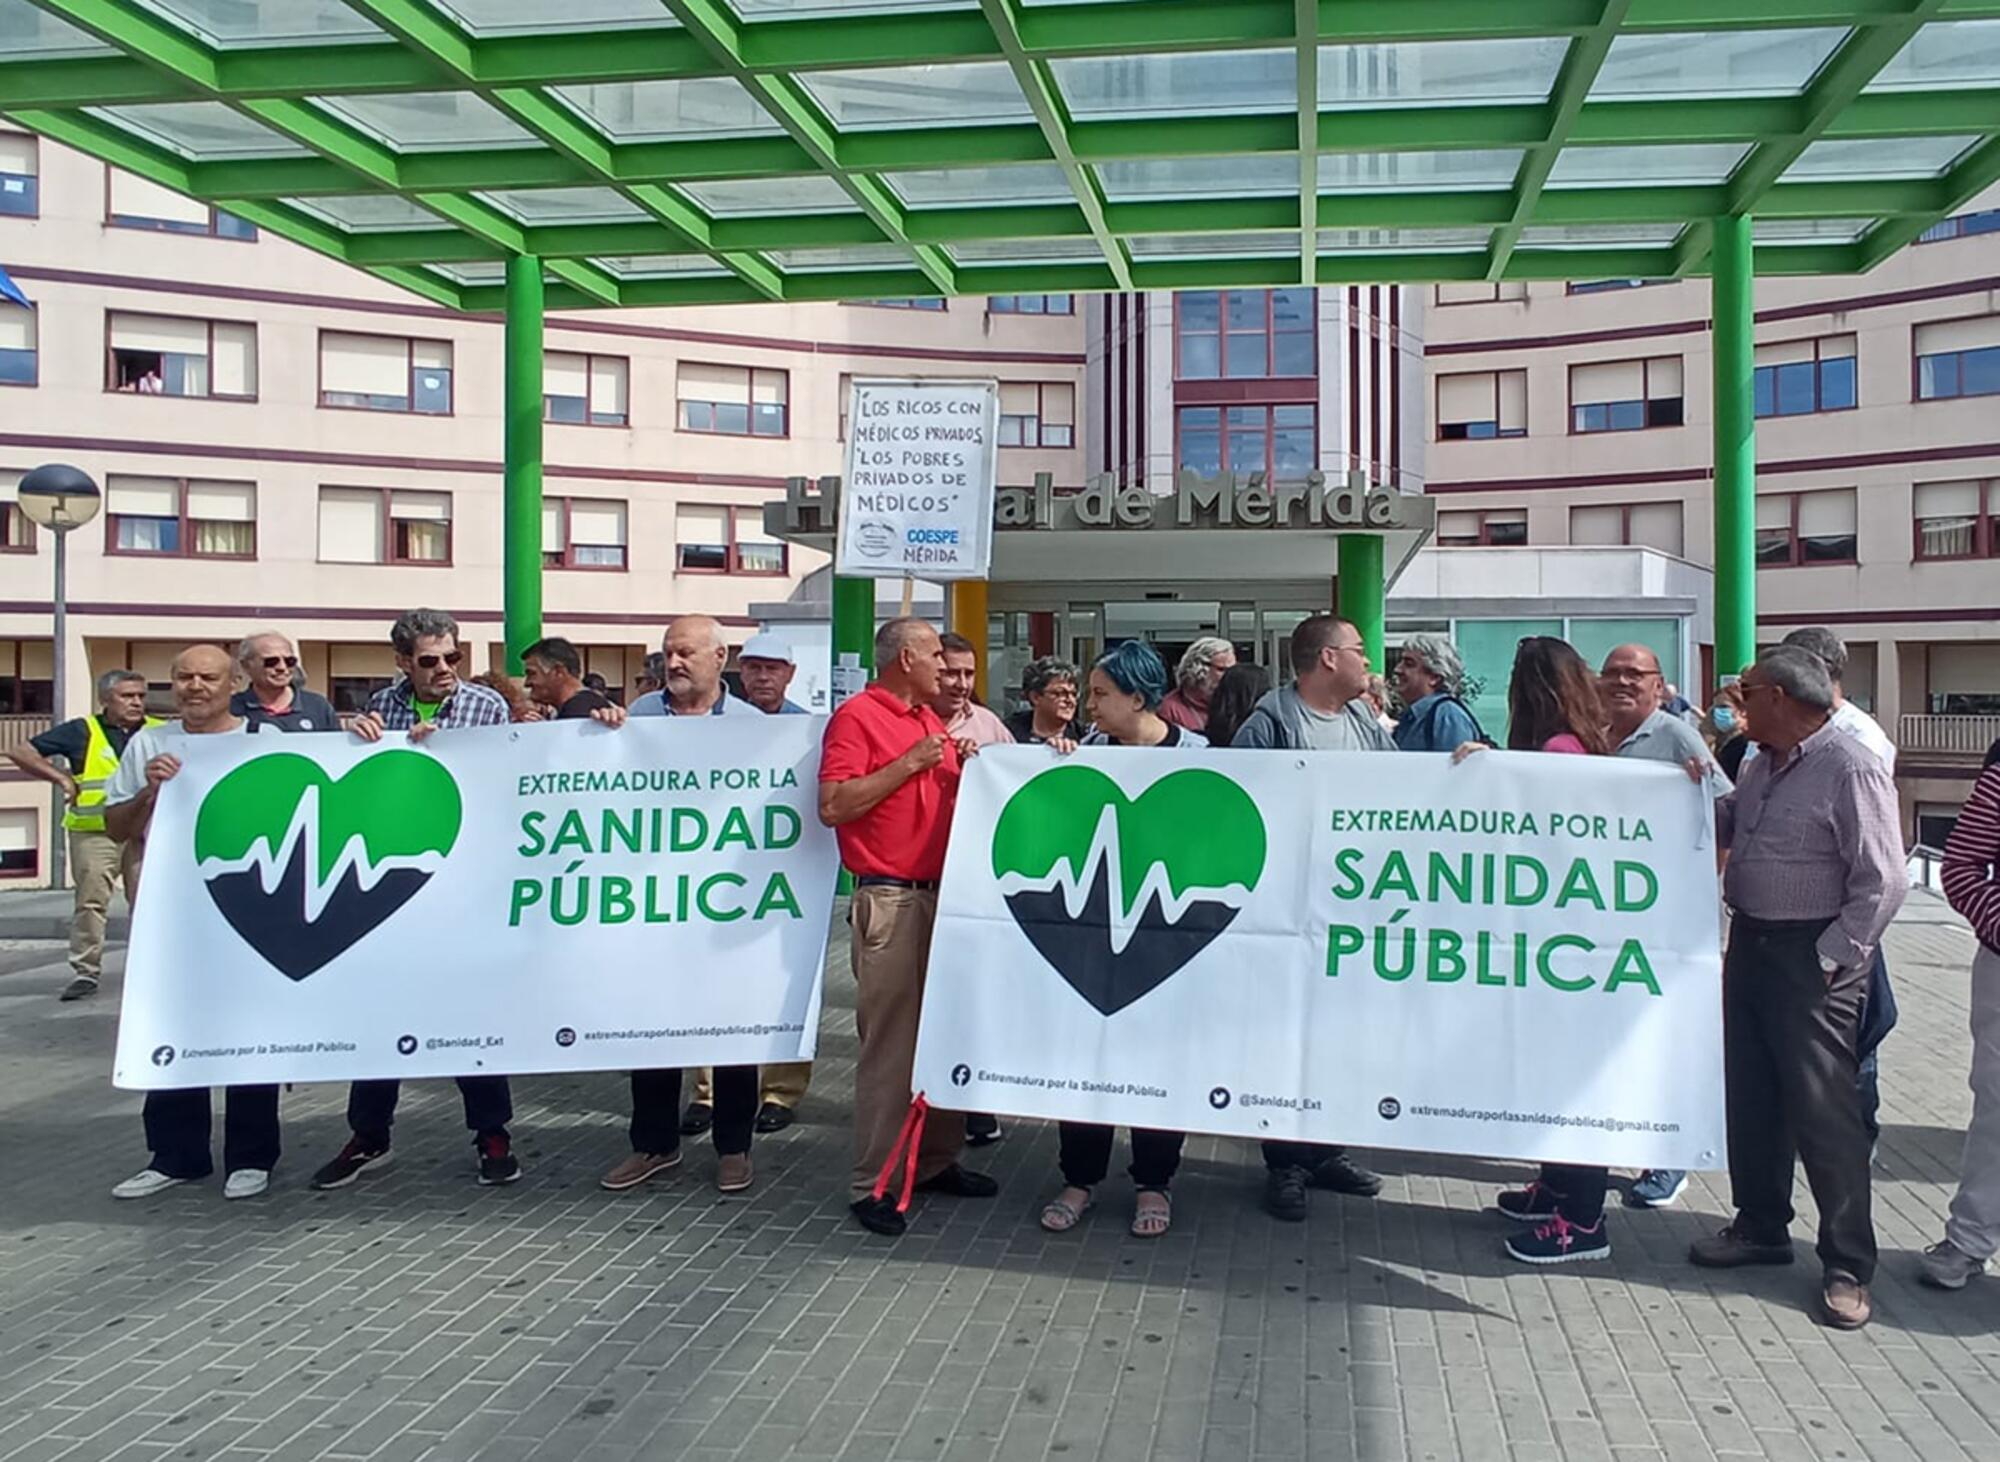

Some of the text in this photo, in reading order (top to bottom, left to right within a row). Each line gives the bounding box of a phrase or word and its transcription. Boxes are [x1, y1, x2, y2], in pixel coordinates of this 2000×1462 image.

[897, 401, 942, 415] RICOS
[947, 401, 981, 415] CON
[856, 423, 919, 442] MÉDICOS
[902, 451, 964, 467] POBRES
[854, 472, 966, 486] PRIVADOS DE
[1074, 472, 1155, 525] de
[1177, 470, 1402, 526] Mérida
[907, 529, 959, 544] COESPE
[903, 547, 958, 563] MÉRIDA
[518, 768, 798, 796] EXTREMADURA POR LA
[517, 805, 803, 858] SANIDAD
[1331, 809, 1653, 842] EXTREMADURA POR LA
[1331, 848, 1659, 913] SANIDAD
[508, 860, 803, 927] PÚBLICA
[1325, 908, 1663, 997] PÚBLICA
[269, 1042, 314, 1054] Sanidad
[977, 1070, 1168, 1098] Extremadura por la Sanidad Pública
[1239, 1094, 1322, 1112] @Sanidad_Ext
